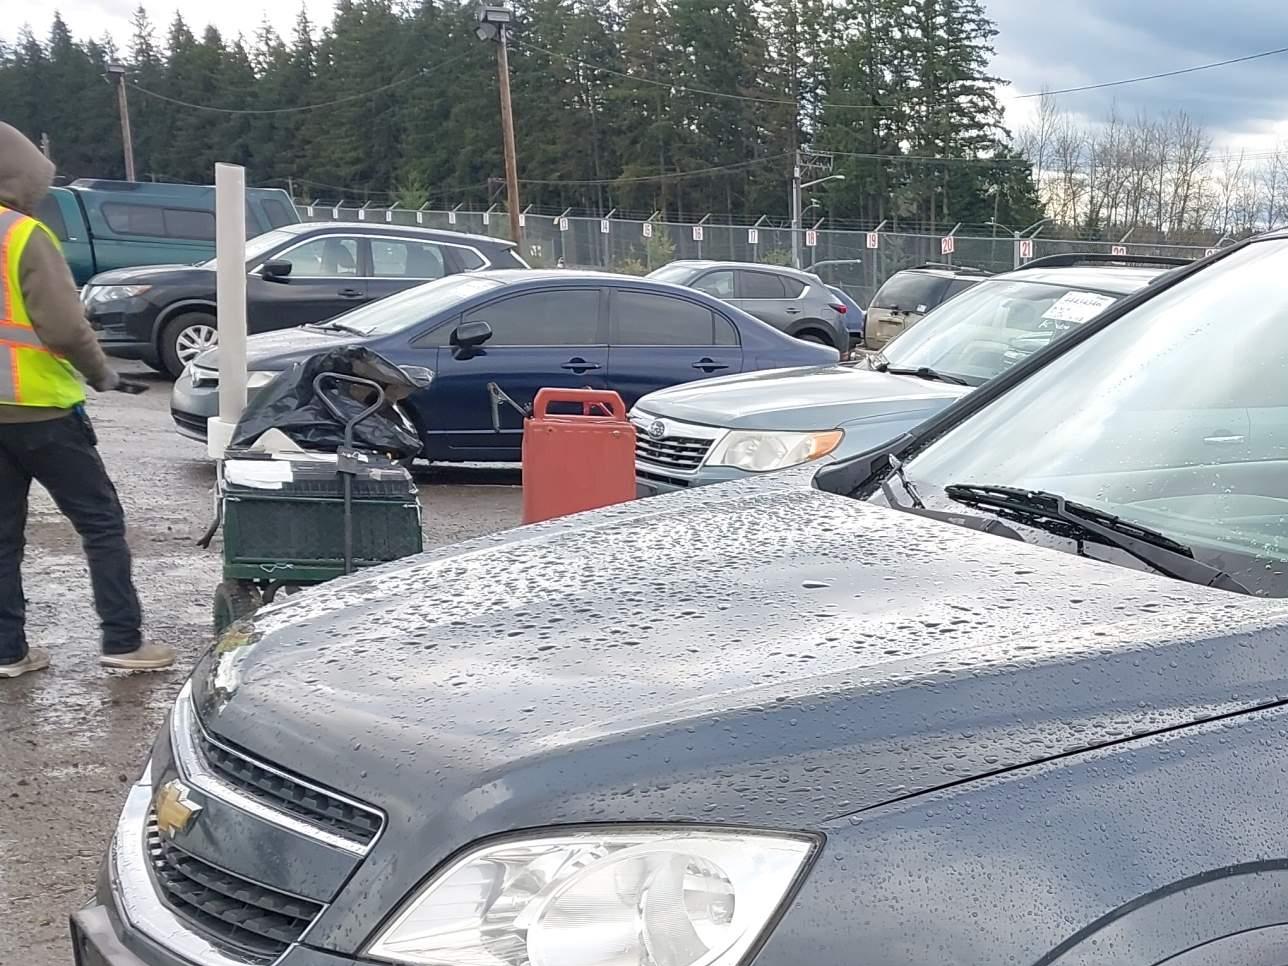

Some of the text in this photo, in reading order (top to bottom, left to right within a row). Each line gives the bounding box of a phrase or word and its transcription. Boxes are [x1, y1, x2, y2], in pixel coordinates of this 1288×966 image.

[868, 233, 877, 247] 19
[942, 237, 953, 252] 20
[1022, 241, 1031, 256] 21
